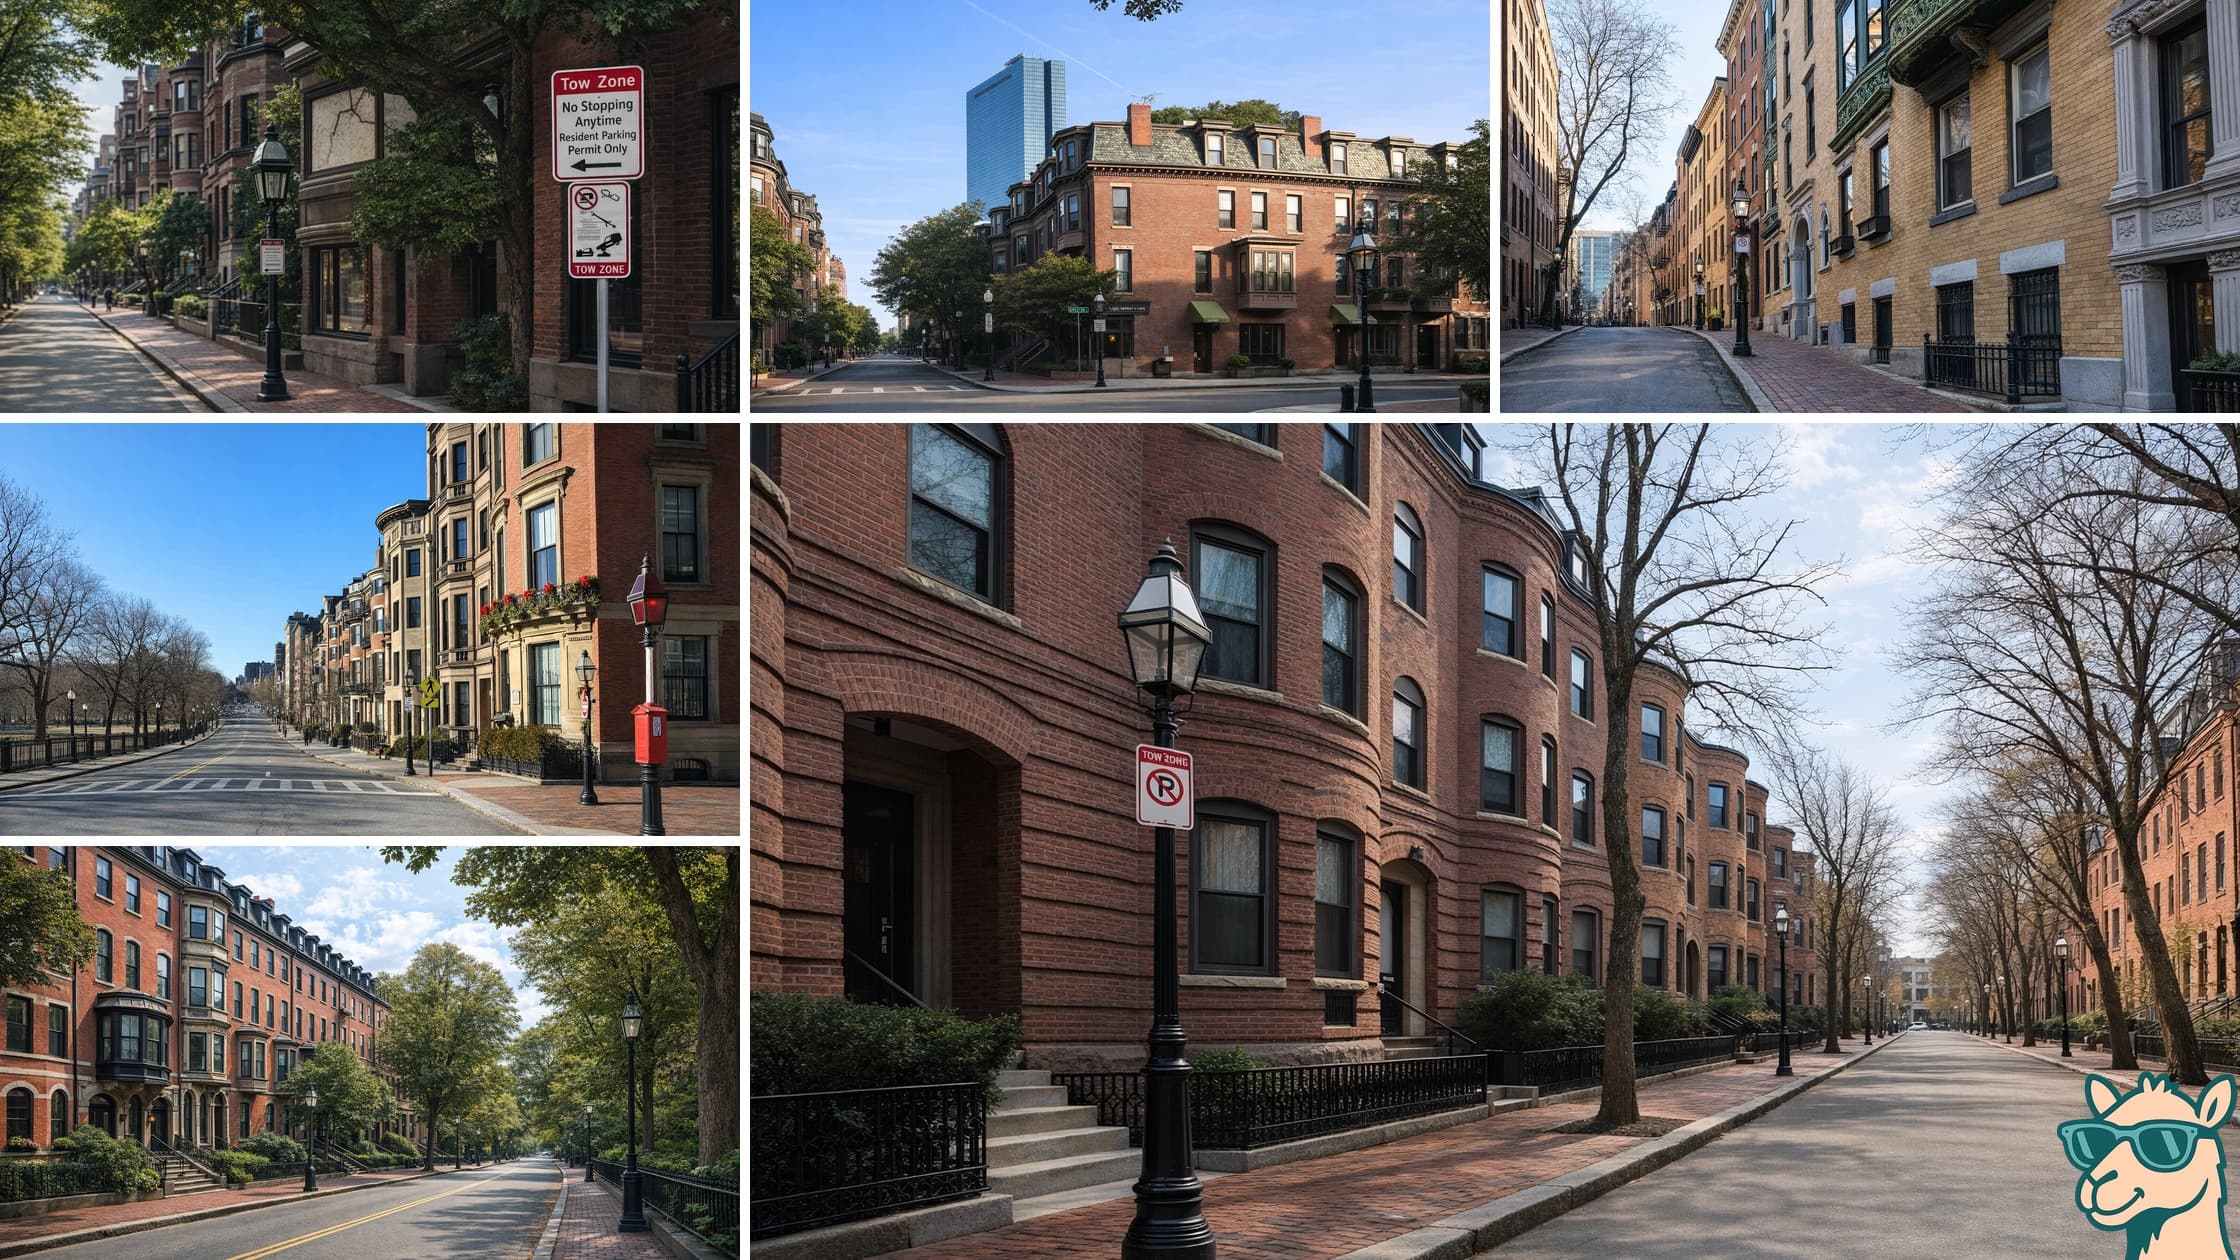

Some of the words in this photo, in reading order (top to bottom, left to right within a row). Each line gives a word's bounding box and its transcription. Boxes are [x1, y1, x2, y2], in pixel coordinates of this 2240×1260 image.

[560, 77, 590, 91] Tow
[597, 75, 636, 88] Zone
[562, 101, 578, 113] No
[581, 98, 633, 113] Stopping
[575, 114, 622, 130] Anytime
[559, 131, 599, 142] Resident
[601, 130, 637, 141] Parking
[568, 144, 601, 156] Permit
[604, 143, 628, 156] Only
[575, 264, 596, 274] TOW
[599, 264, 625, 274] ZONE
[1142, 750, 1162, 762] TOW
